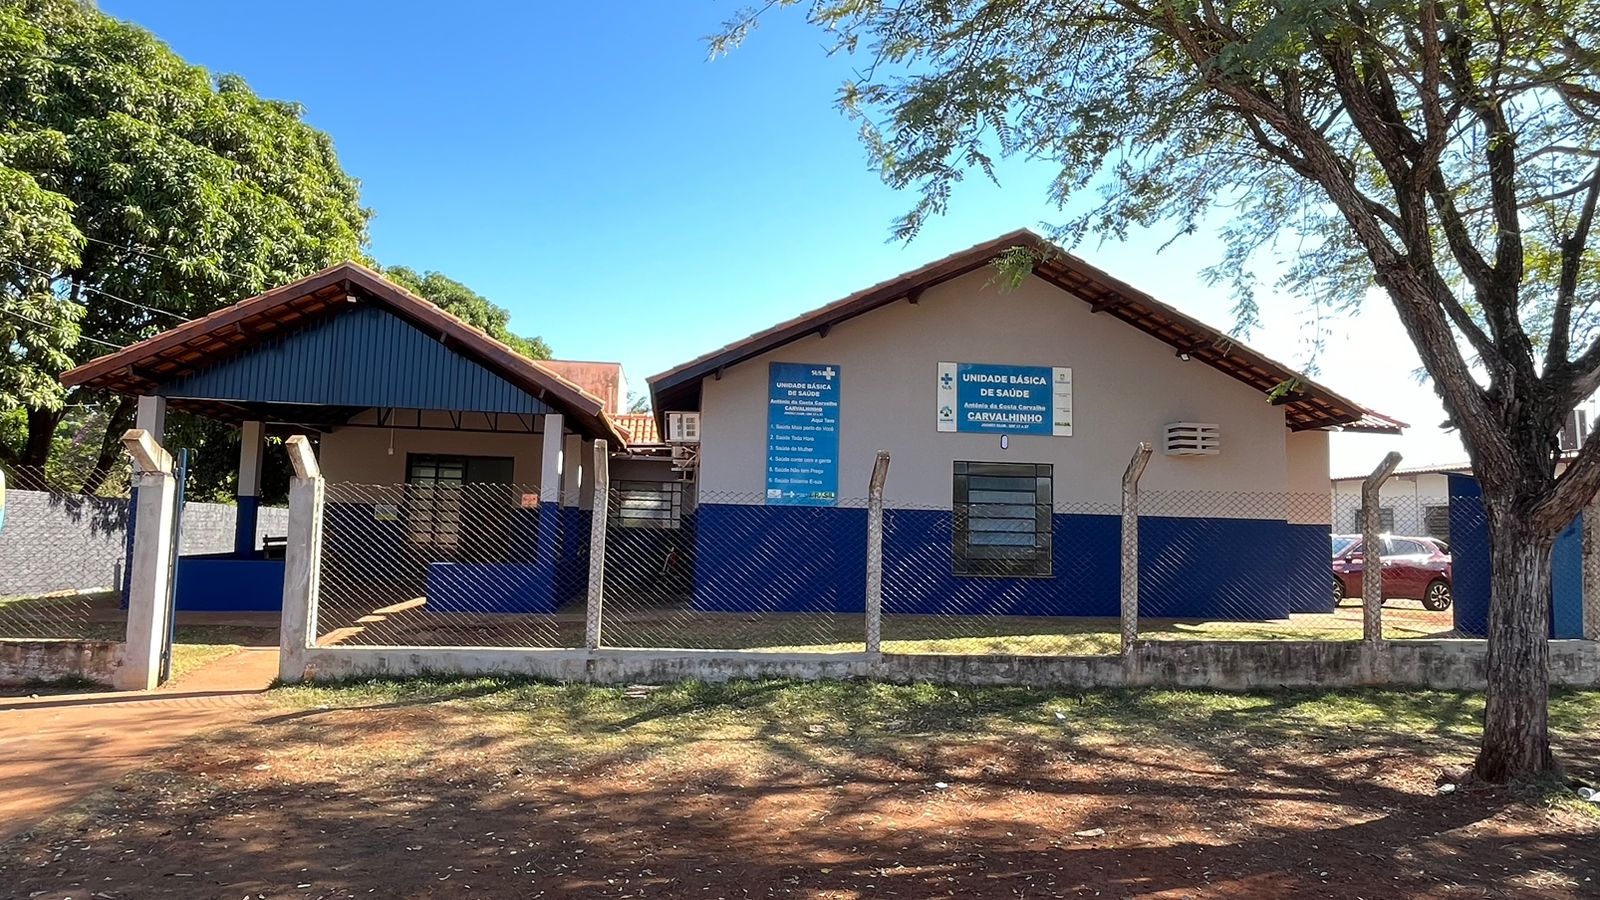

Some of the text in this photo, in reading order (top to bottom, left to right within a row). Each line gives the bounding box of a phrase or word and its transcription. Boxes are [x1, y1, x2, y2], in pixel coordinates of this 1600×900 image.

[962, 374, 1047, 385] UNIDADE BÁSICA
[980, 388, 1030, 398] DE SAÚDE
[967, 412, 1043, 422] CARVALHINHO
